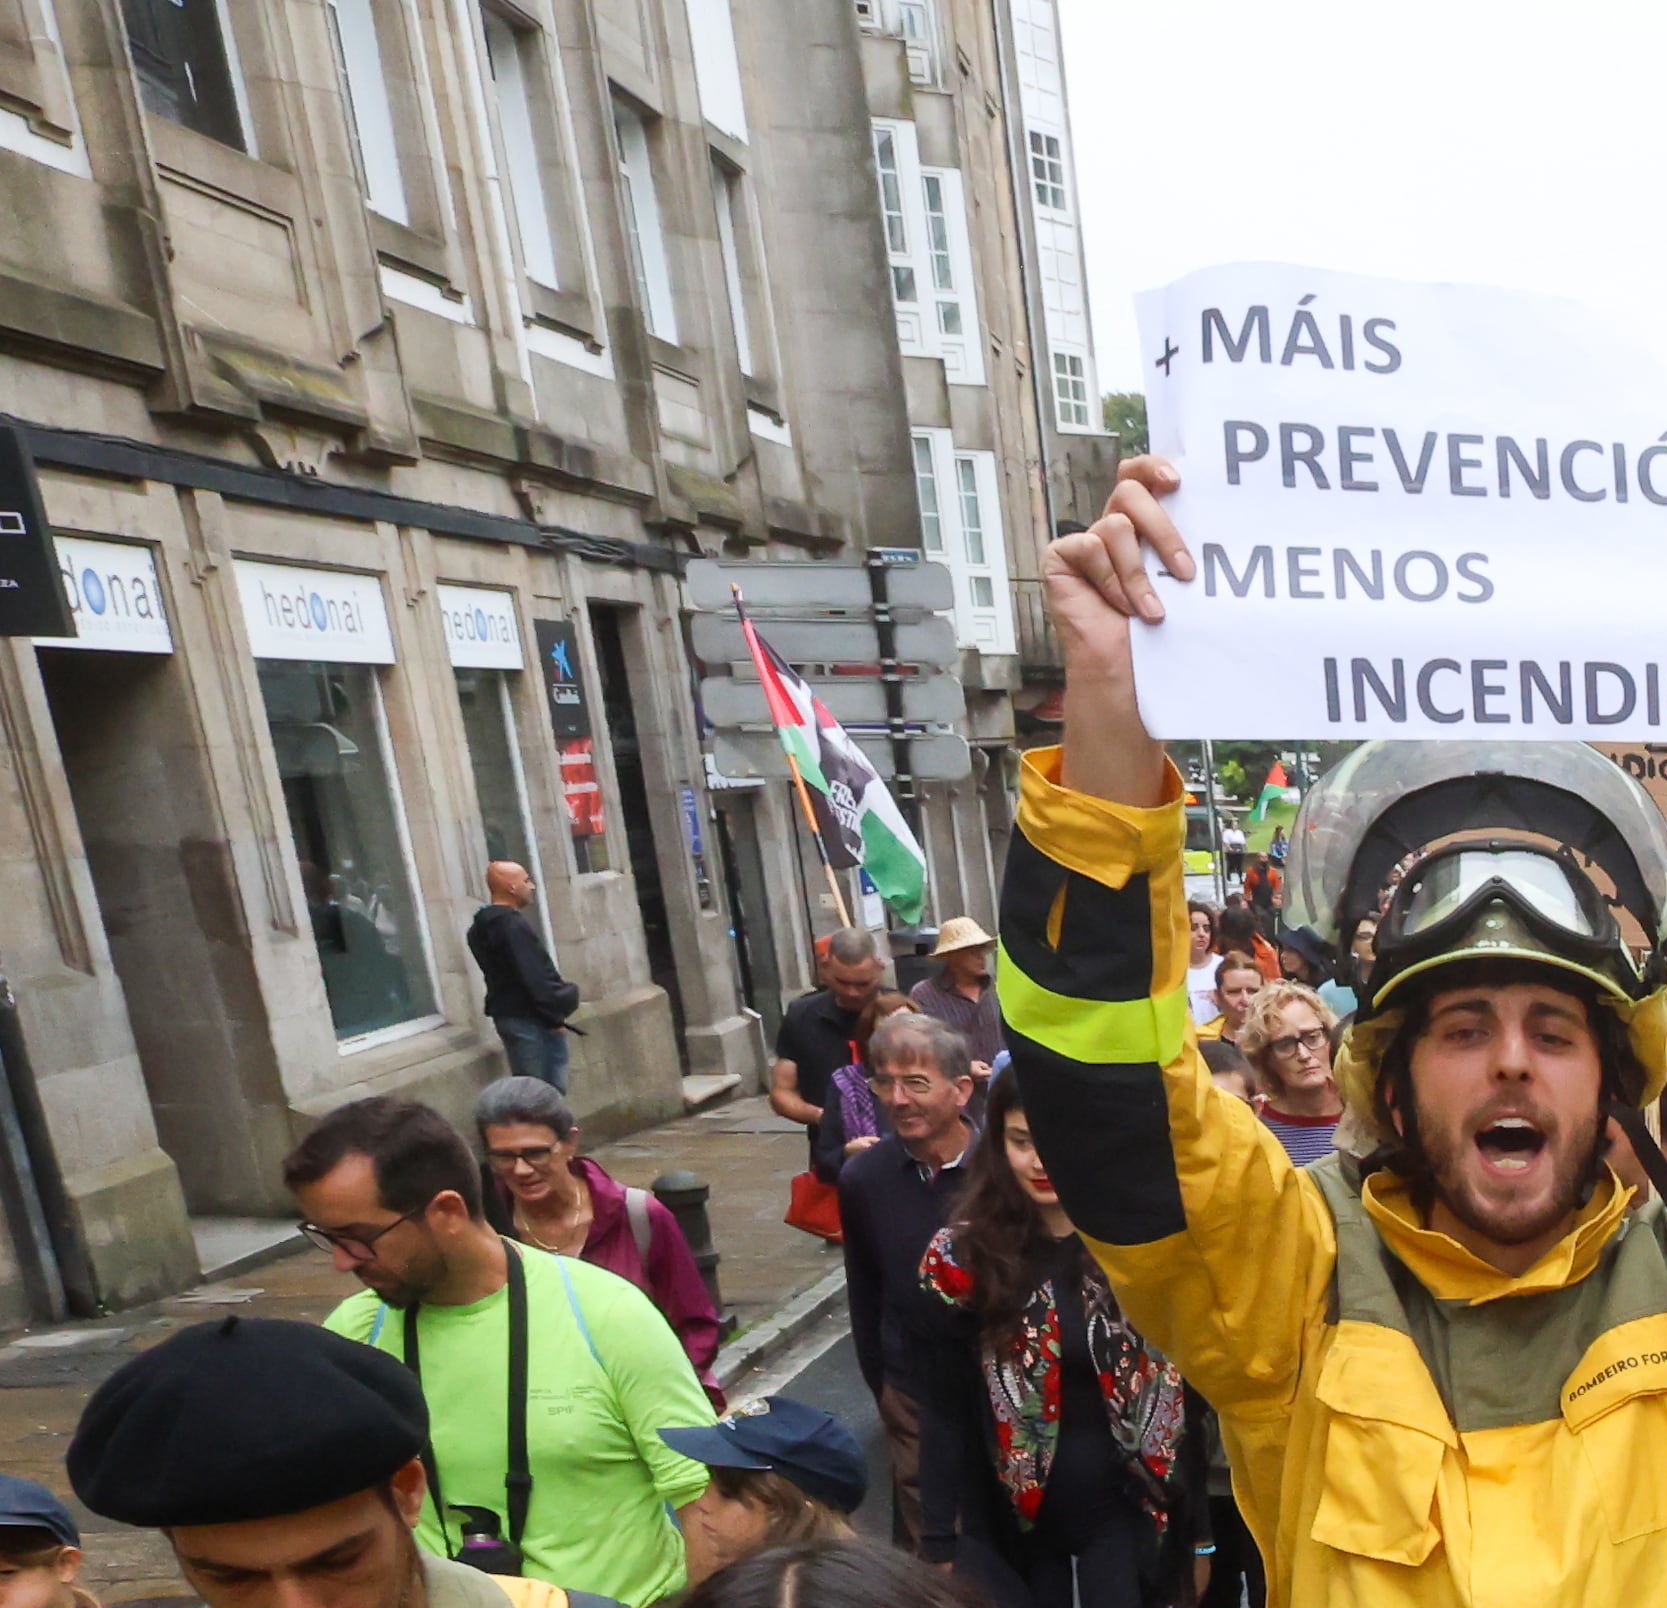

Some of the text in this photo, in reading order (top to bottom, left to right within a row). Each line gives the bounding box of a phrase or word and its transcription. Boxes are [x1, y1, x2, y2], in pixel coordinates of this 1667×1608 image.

[1202, 294, 1402, 375] MÁIS
[1202, 542, 1495, 603] MENOS
[259, 580, 365, 634] hedonai
[1569, 1357, 1639, 1402] BOMBEIRO
